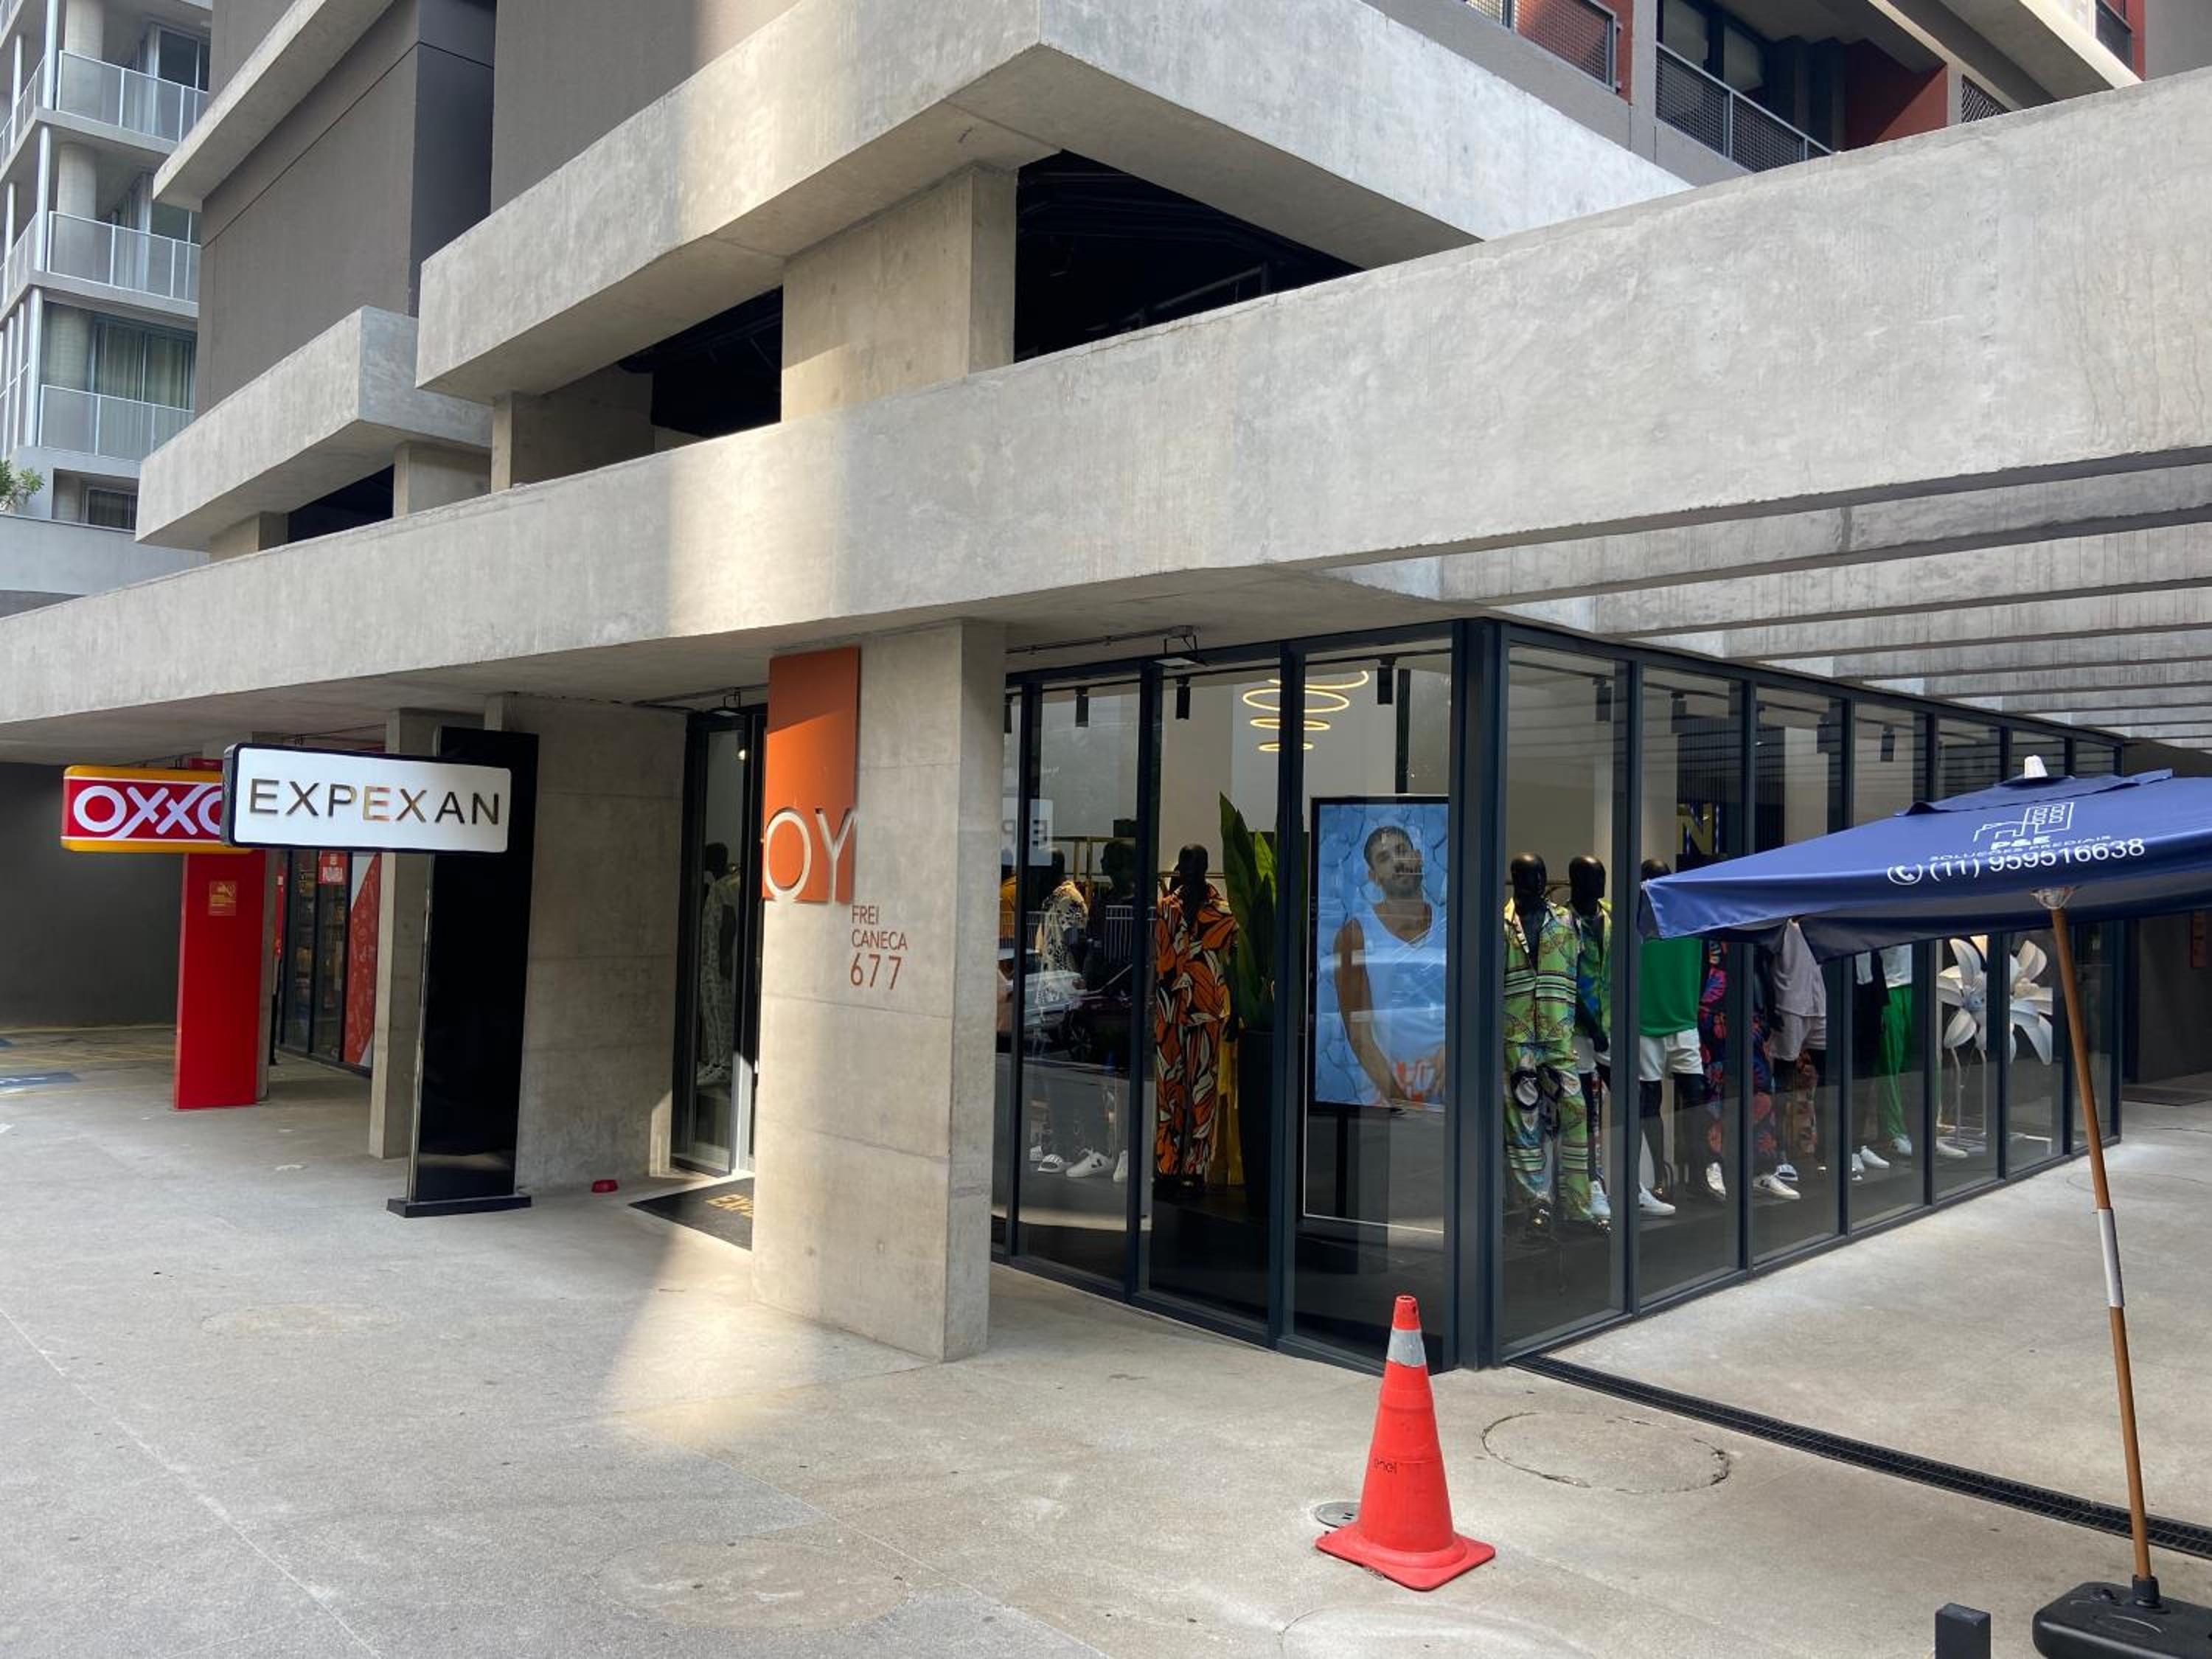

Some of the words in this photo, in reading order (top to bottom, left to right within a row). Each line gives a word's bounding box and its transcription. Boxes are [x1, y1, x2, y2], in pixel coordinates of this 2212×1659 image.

[248, 778, 499, 825] EXPEXAN
[1930, 857, 1980, 882] (11)
[1990, 838, 2146, 872] 959516638
[852, 905, 880, 925] FREI
[852, 928, 908, 950] CANECA
[850, 953, 902, 990] 677
